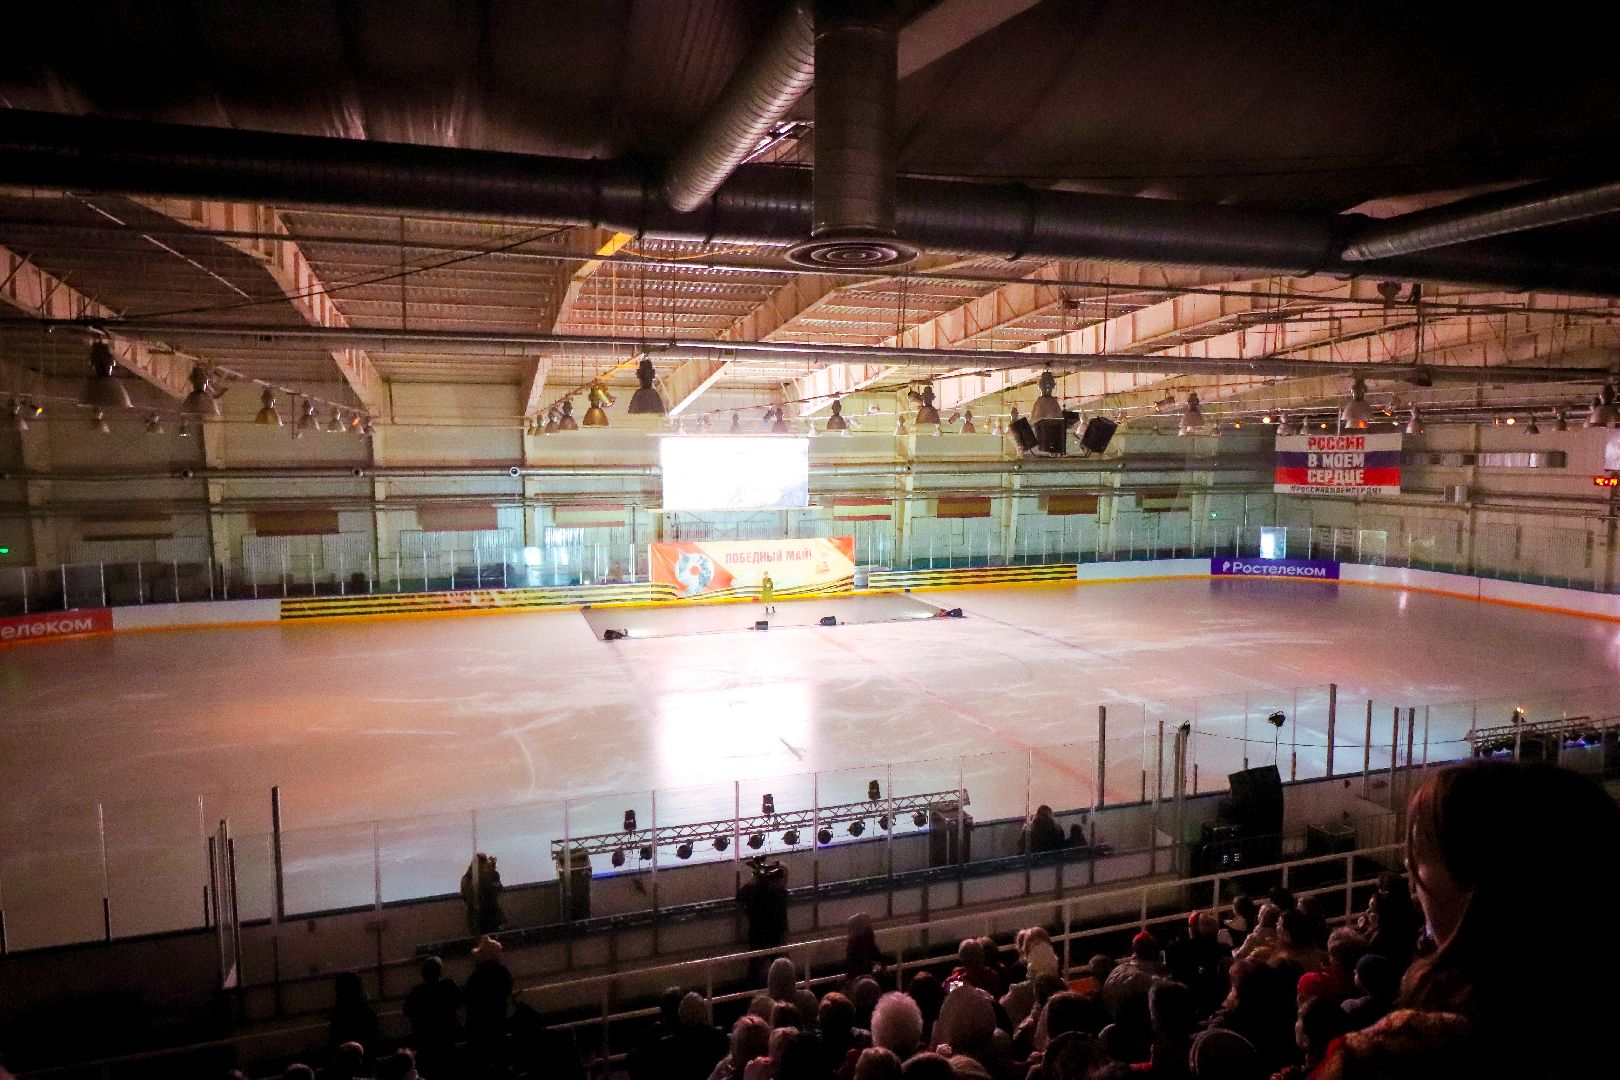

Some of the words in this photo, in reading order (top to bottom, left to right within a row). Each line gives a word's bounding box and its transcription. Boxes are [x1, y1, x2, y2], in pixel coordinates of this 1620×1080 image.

[1307, 436, 1366, 451] РОССИЯ
[1307, 453, 1319, 467] В
[1322, 453, 1365, 468] МОЕМ
[1307, 469, 1365, 485] СЕРДЦЕ
[725, 549, 783, 564] ПОБЕДНЫЙ
[786, 547, 813, 561] МАЙ!
[1232, 561, 1326, 577] Ростелеком
